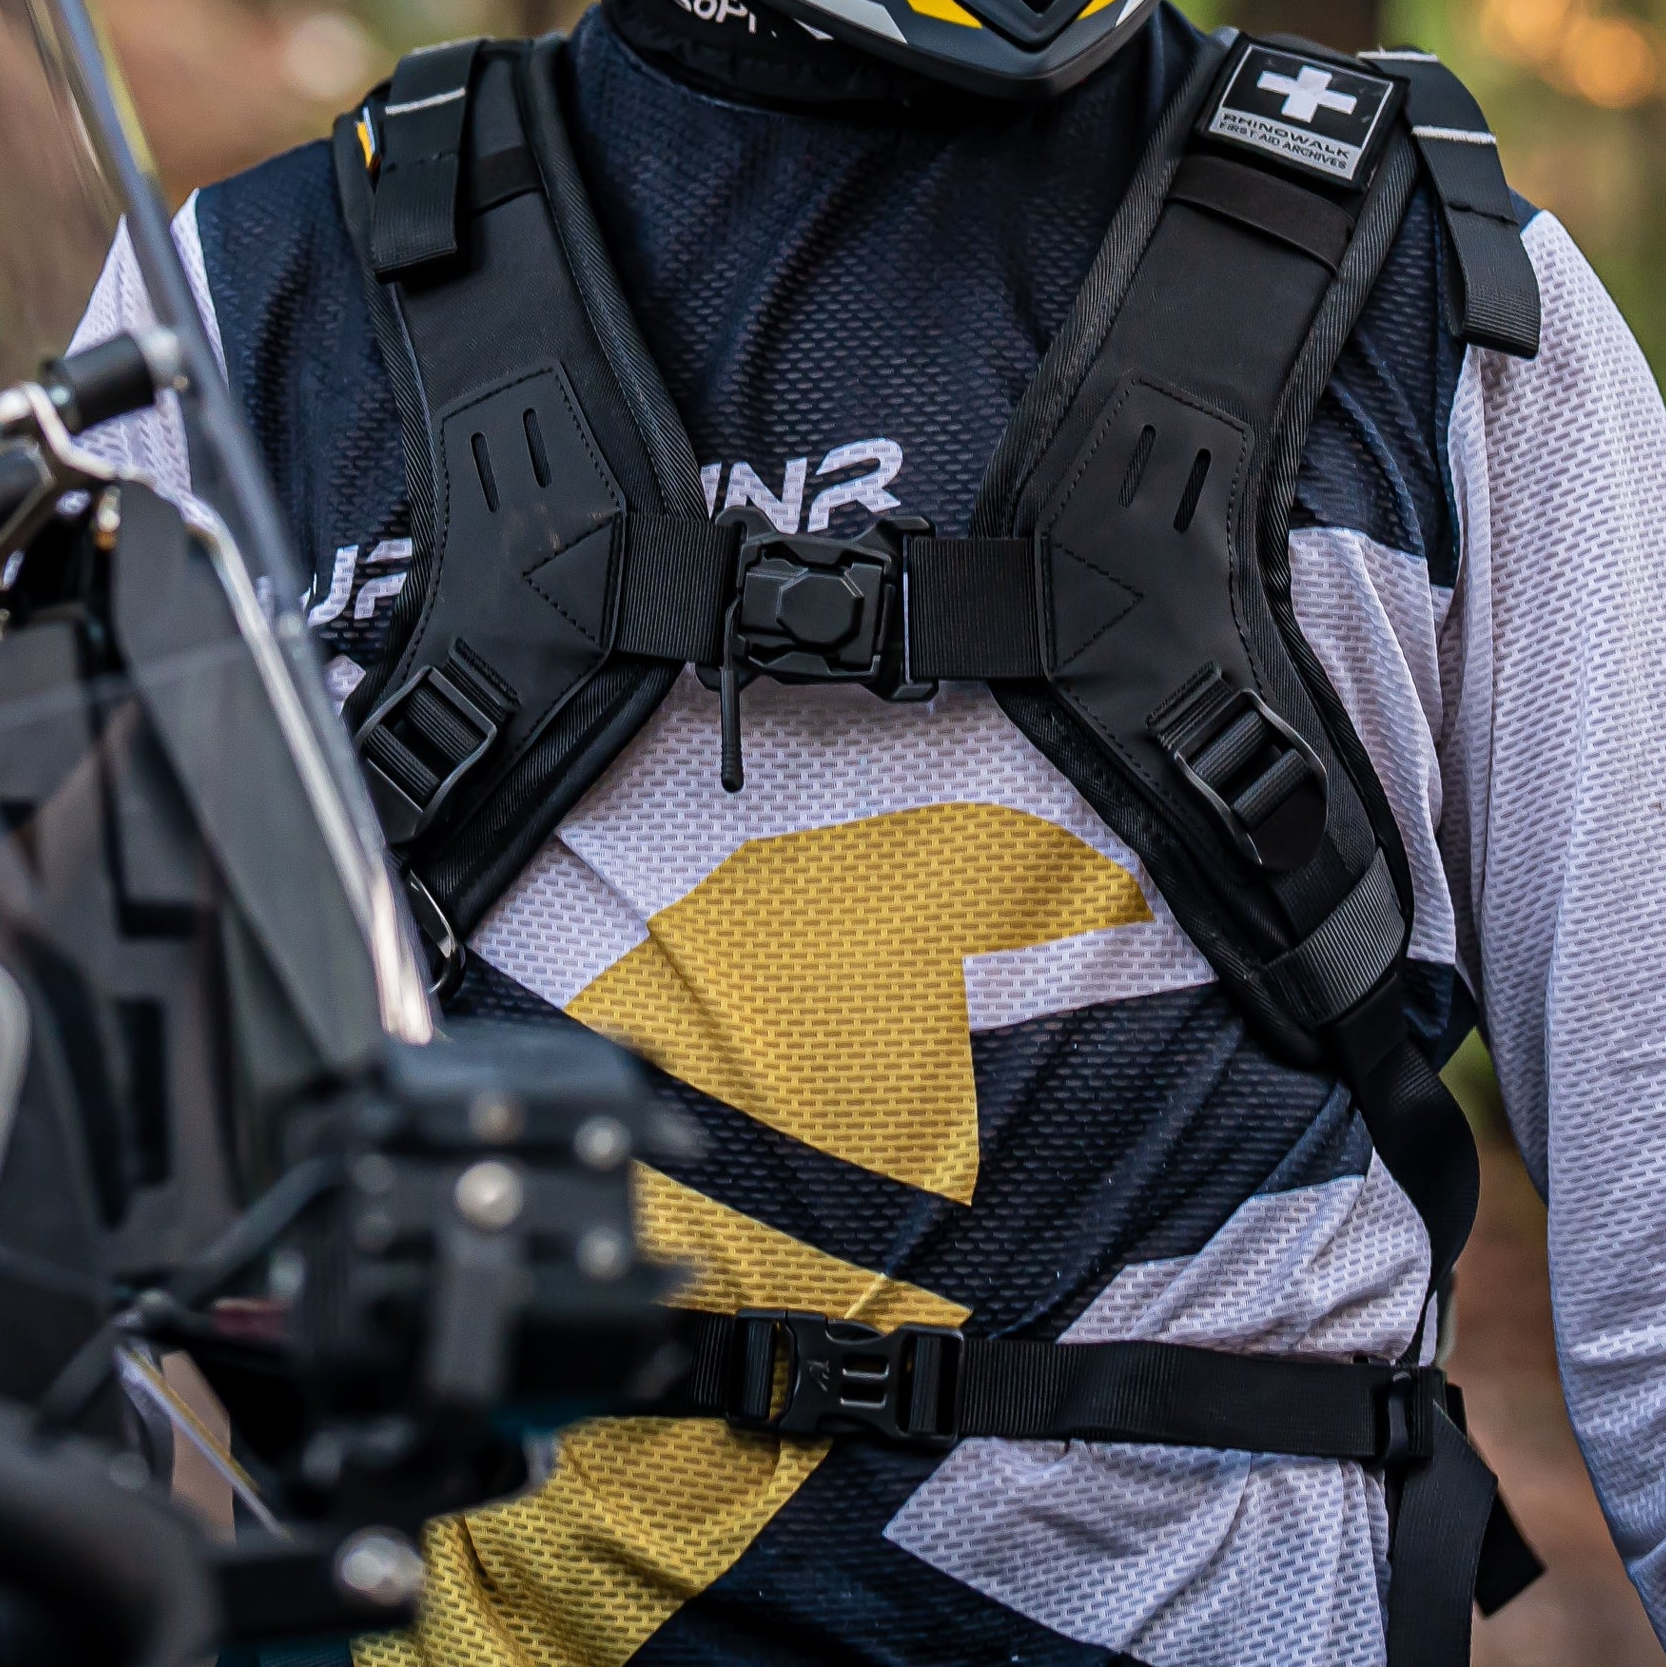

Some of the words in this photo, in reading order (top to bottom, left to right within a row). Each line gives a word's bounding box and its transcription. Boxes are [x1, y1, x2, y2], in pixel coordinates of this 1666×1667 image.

[1219, 121, 1256, 139] FIRST
[1259, 133, 1281, 148] AID
[1222, 112, 1351, 160] RHINOWALK
